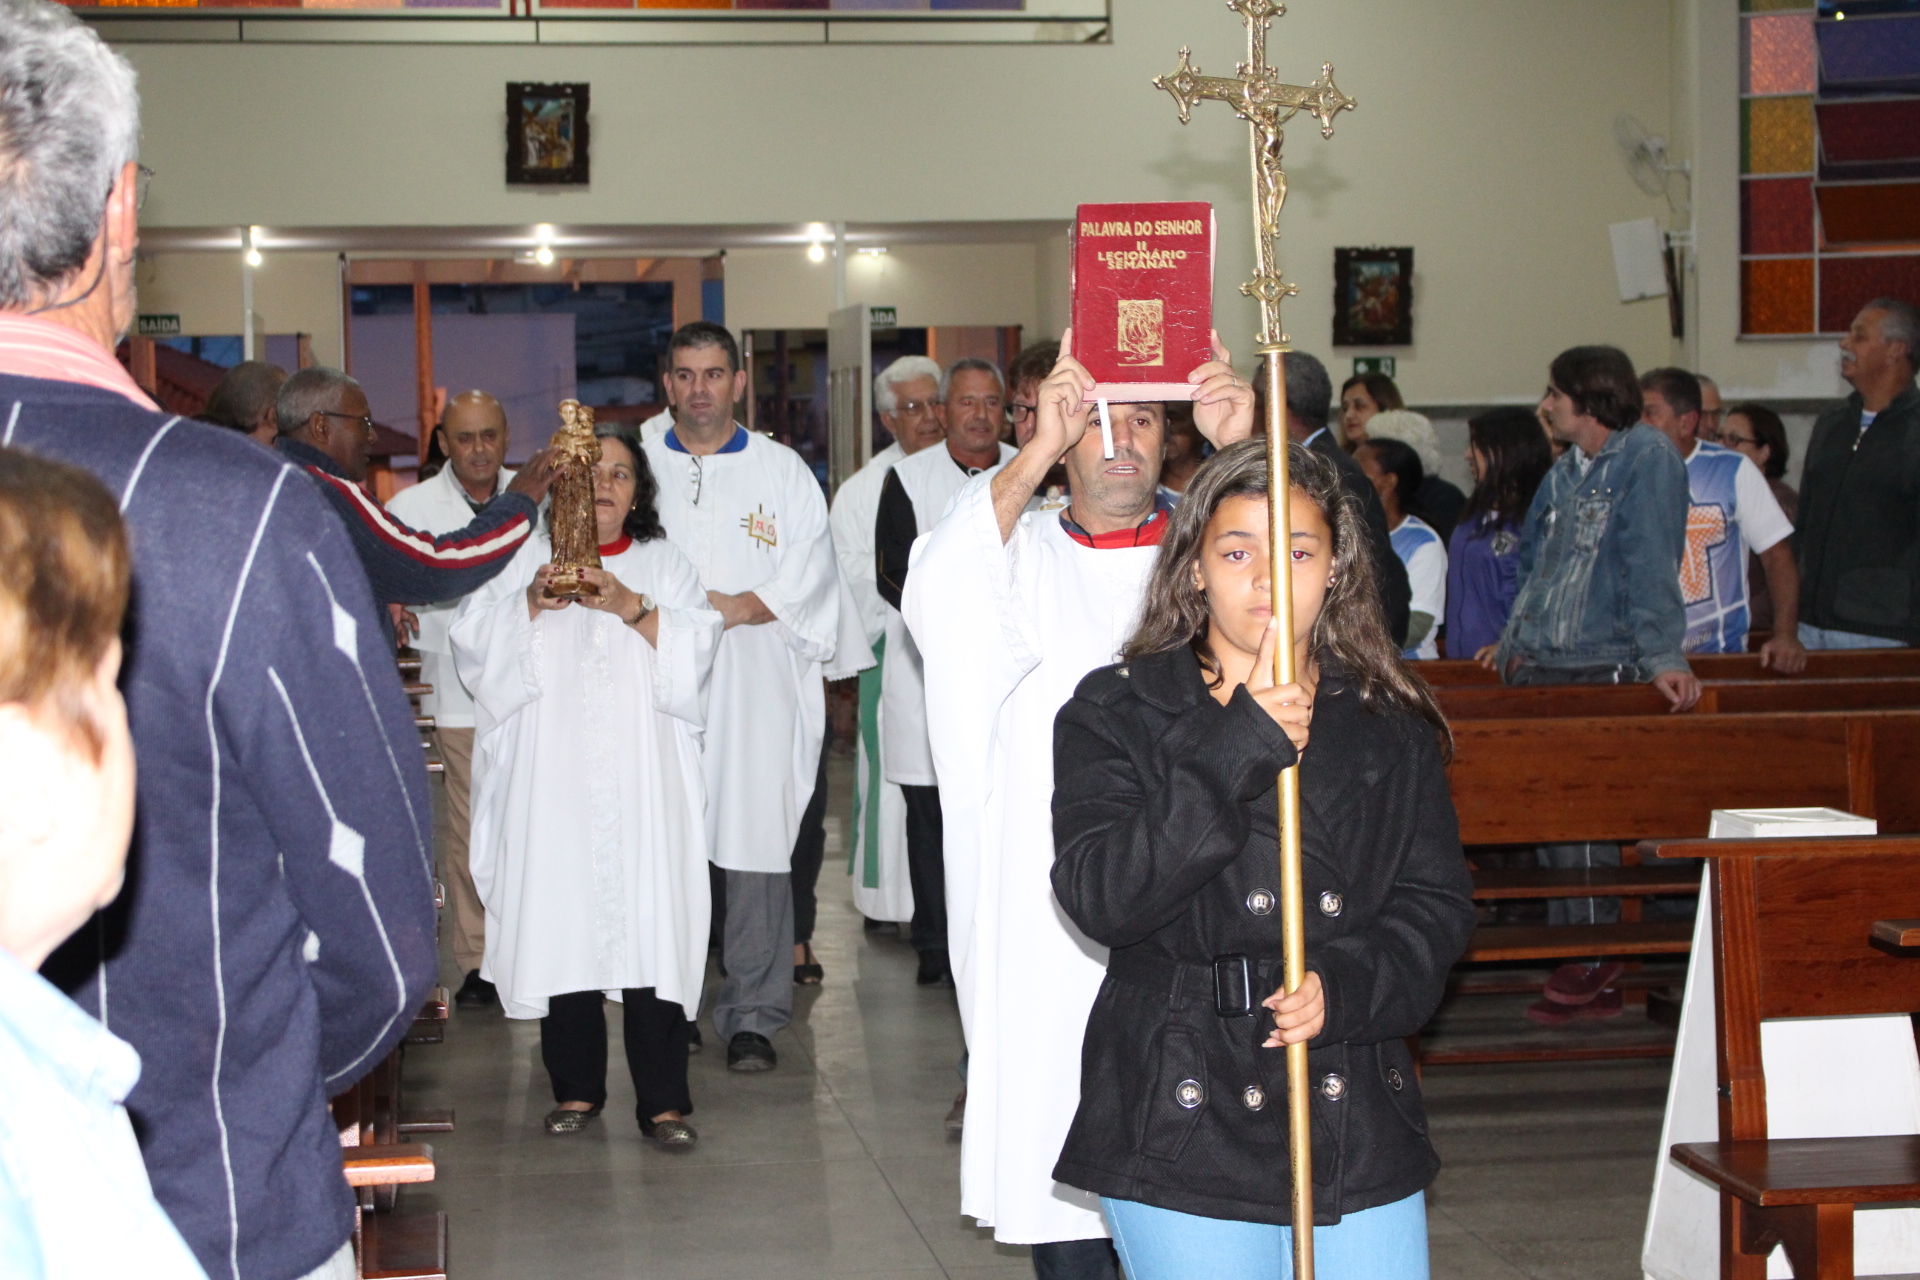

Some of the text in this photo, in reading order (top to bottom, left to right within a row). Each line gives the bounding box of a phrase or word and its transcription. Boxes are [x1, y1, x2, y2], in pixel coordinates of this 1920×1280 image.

[1081, 219, 1202, 237] PALAVRA DO SENHOR
[1097, 248, 1187, 261] LECIONÁRIO
[1107, 260, 1177, 270] SEMANAL
